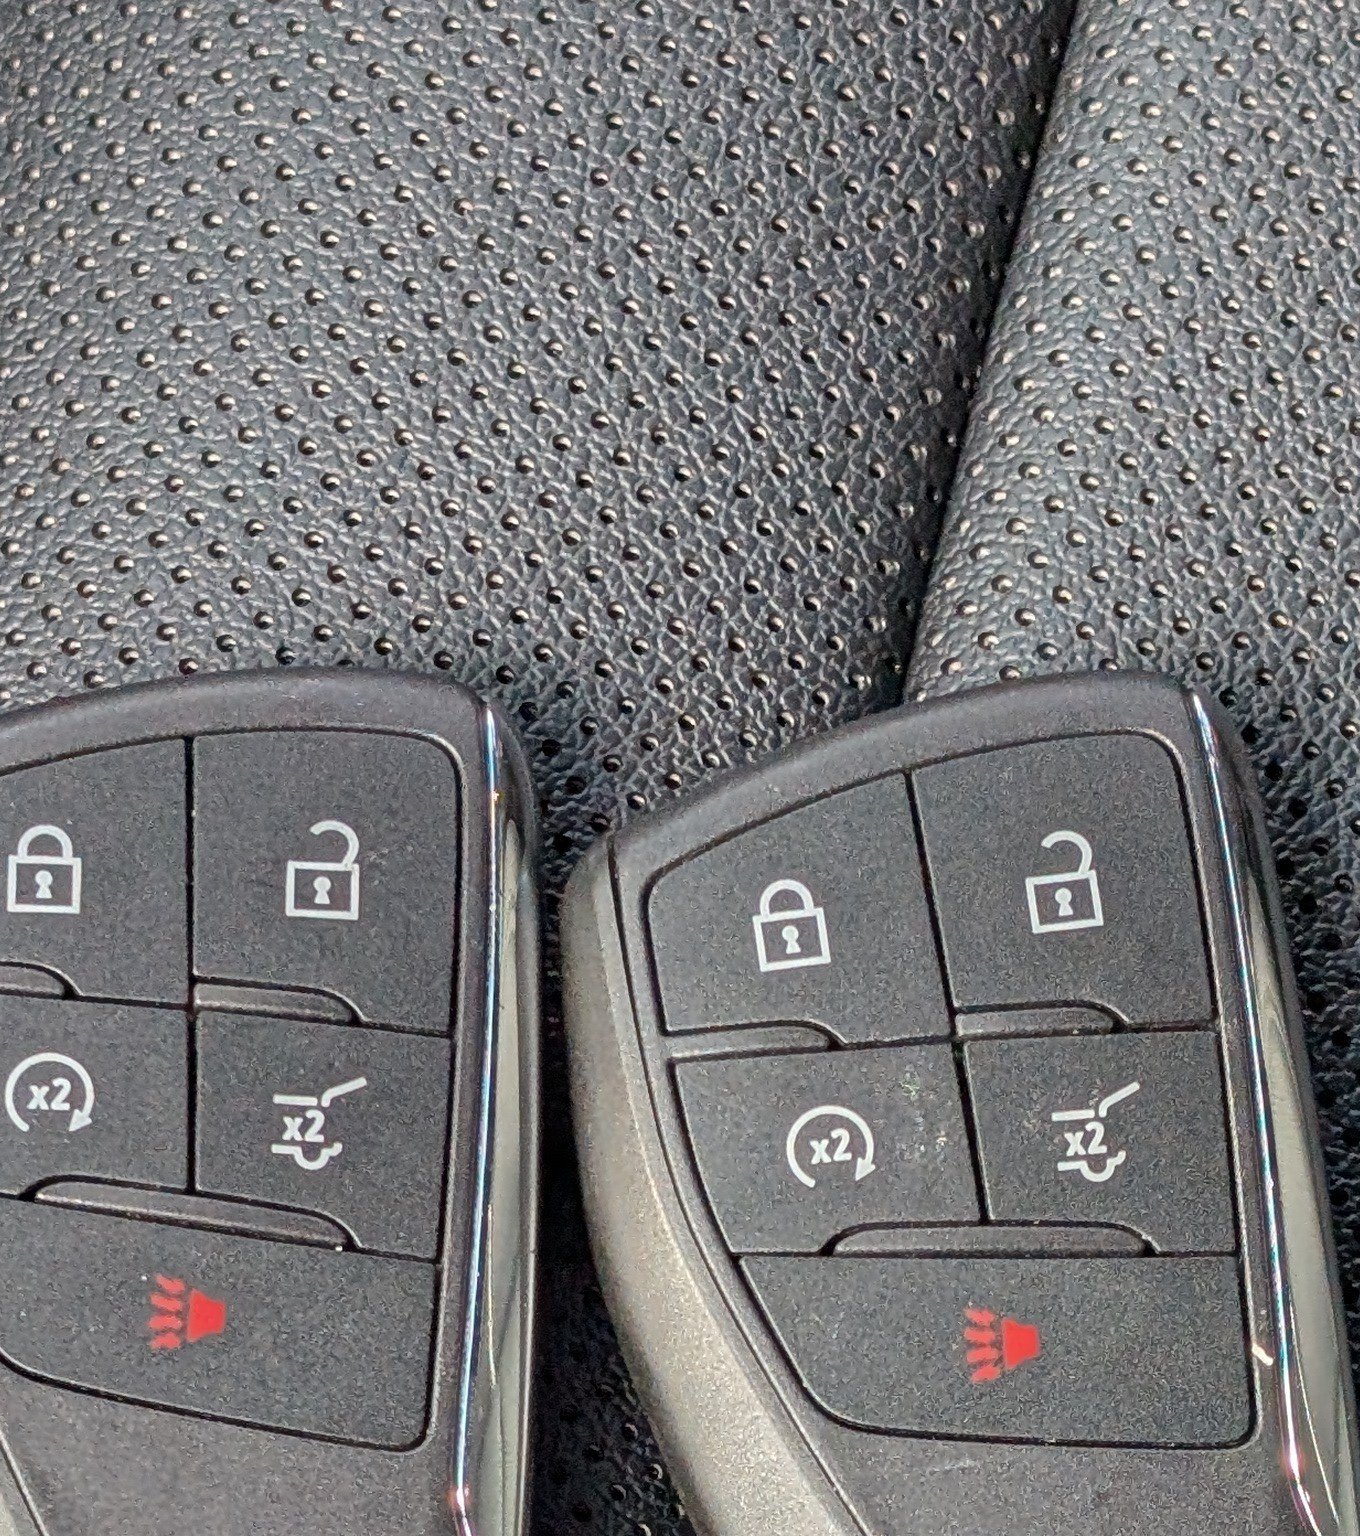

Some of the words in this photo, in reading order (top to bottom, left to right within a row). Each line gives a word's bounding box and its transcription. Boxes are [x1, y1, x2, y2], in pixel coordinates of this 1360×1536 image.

[26, 1076, 72, 1112] x2
[280, 1109, 326, 1143] x2
[1063, 1121, 1108, 1157] x2
[809, 1127, 853, 1166] x2
